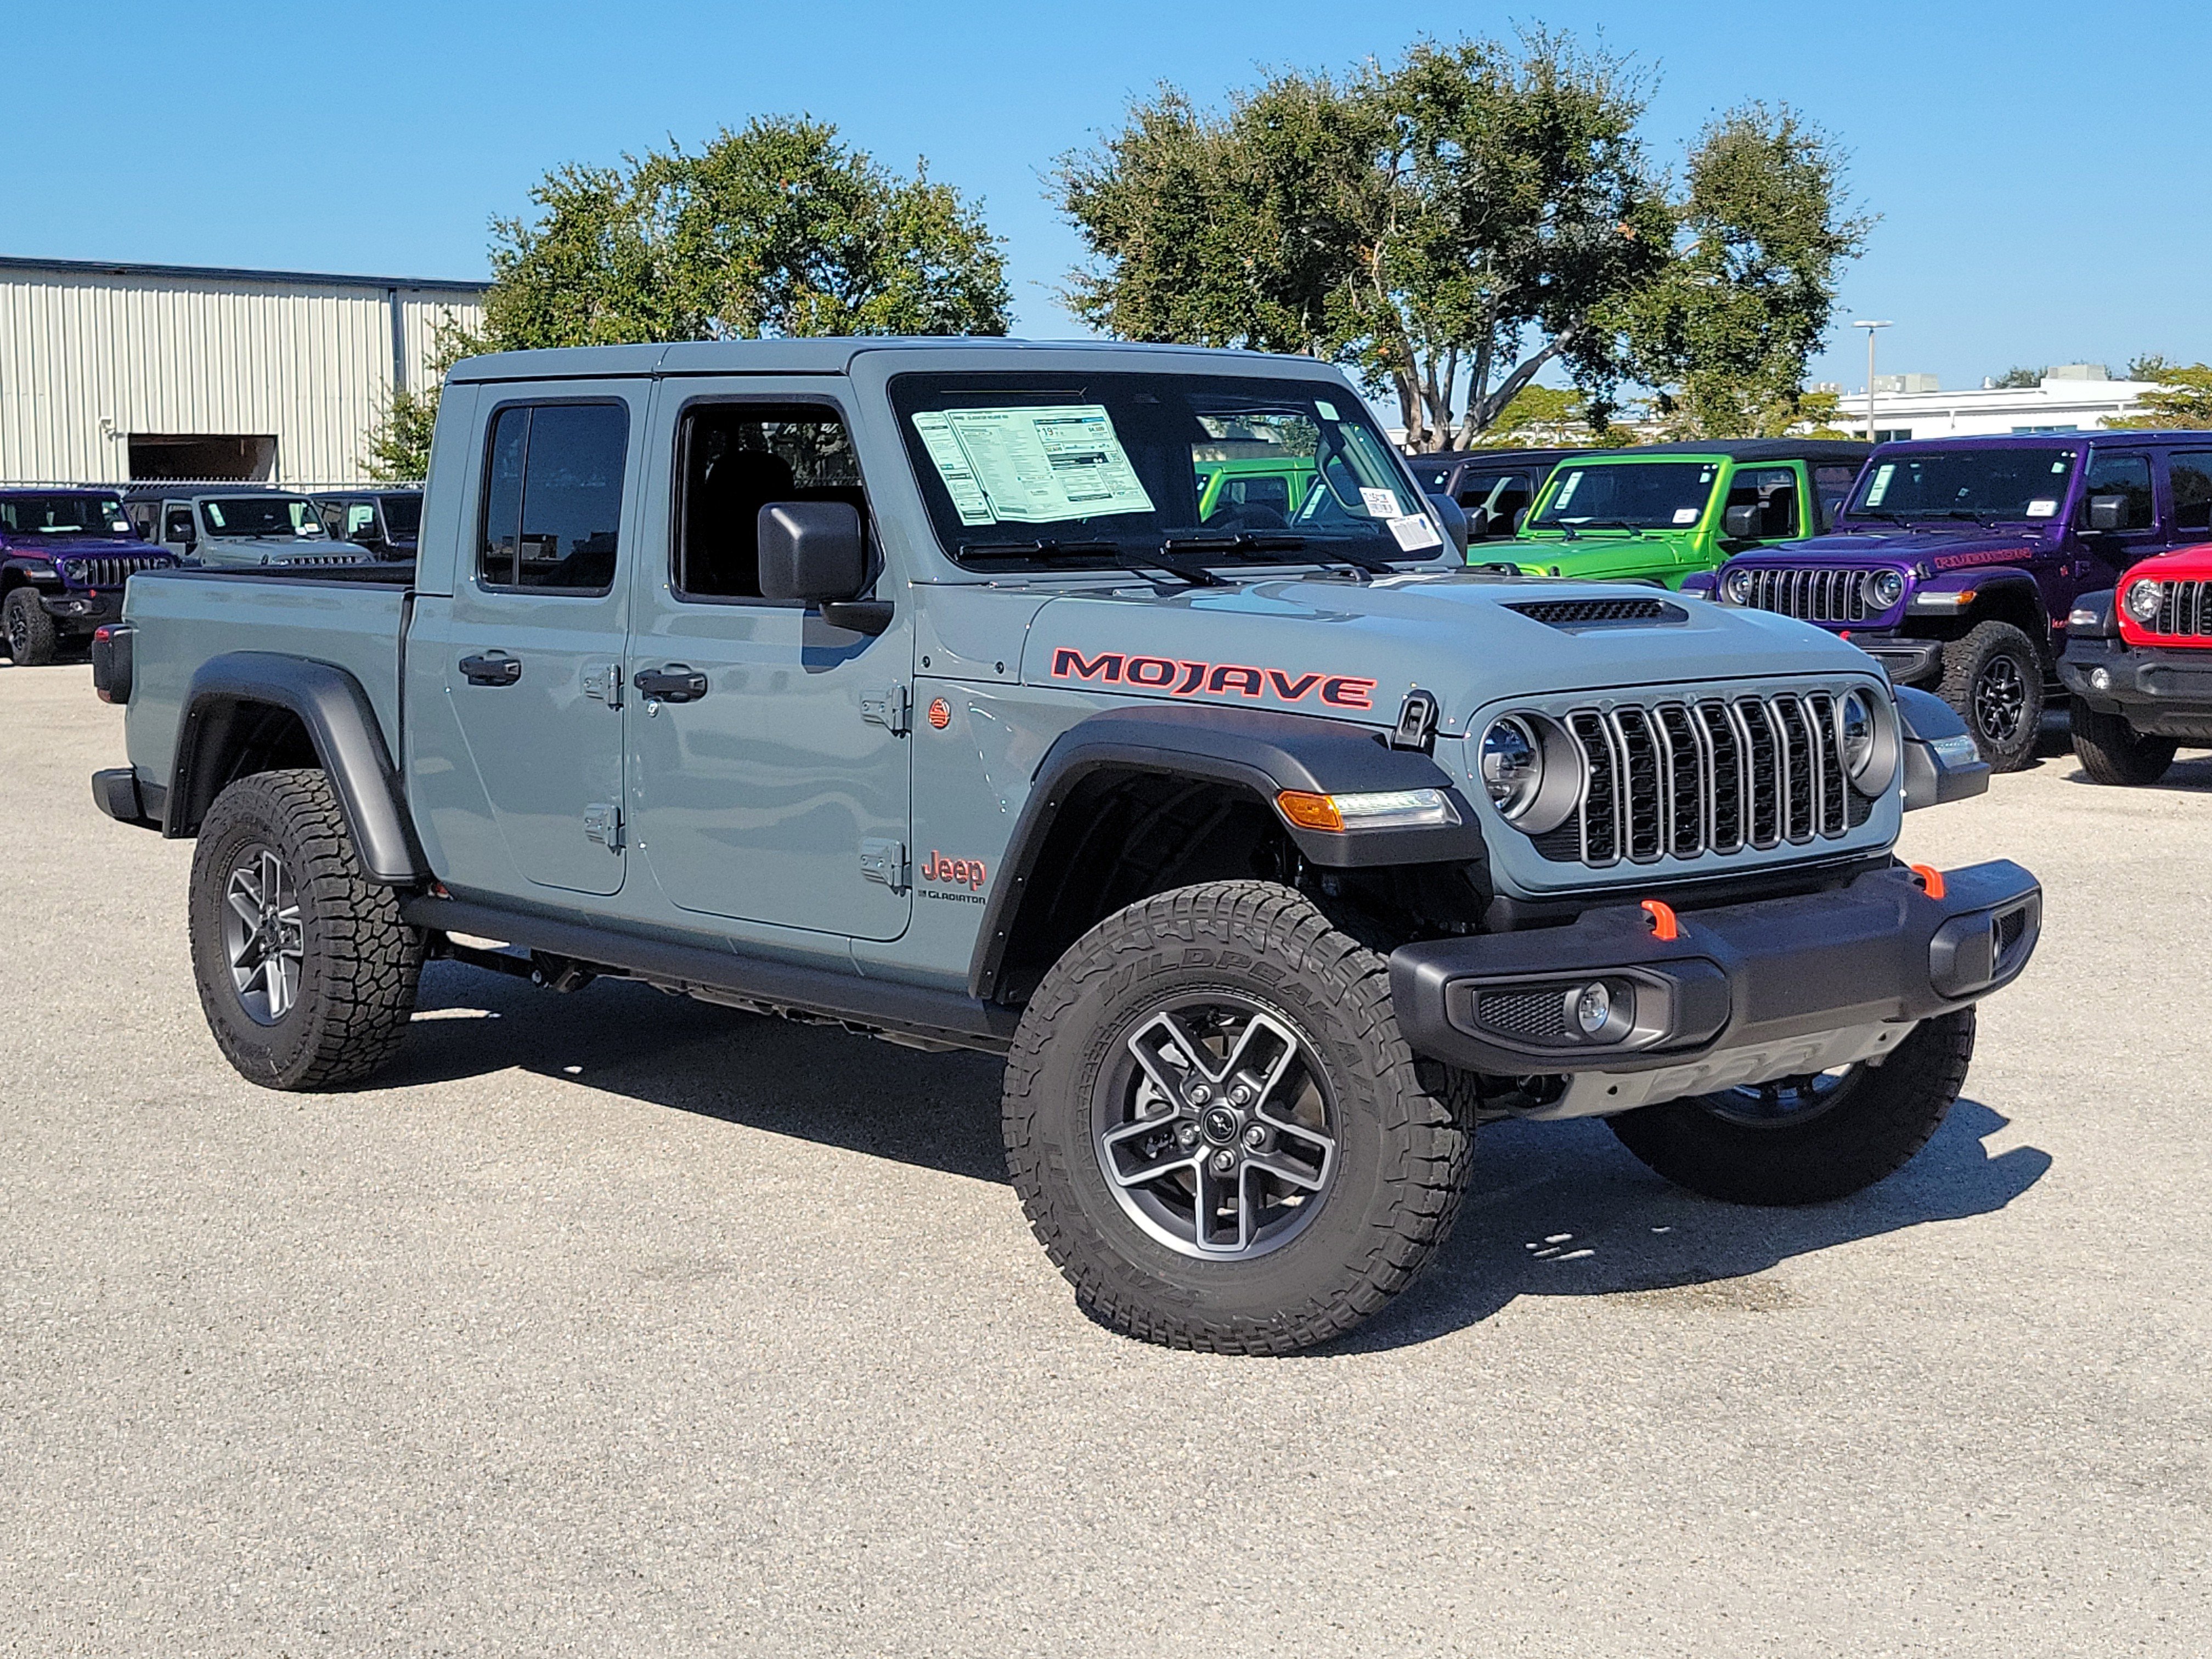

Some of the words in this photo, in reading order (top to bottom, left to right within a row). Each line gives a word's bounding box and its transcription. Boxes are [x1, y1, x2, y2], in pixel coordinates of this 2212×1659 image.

[1042, 427, 1054, 436] 19
[1934, 547, 2032, 569] RUBICON
[1051, 647, 1378, 710] MOJAVE
[921, 850, 986, 891] Jeep
[928, 890, 986, 905] GLADIATOR
[1094, 947, 1344, 1031] WILDPEAK
